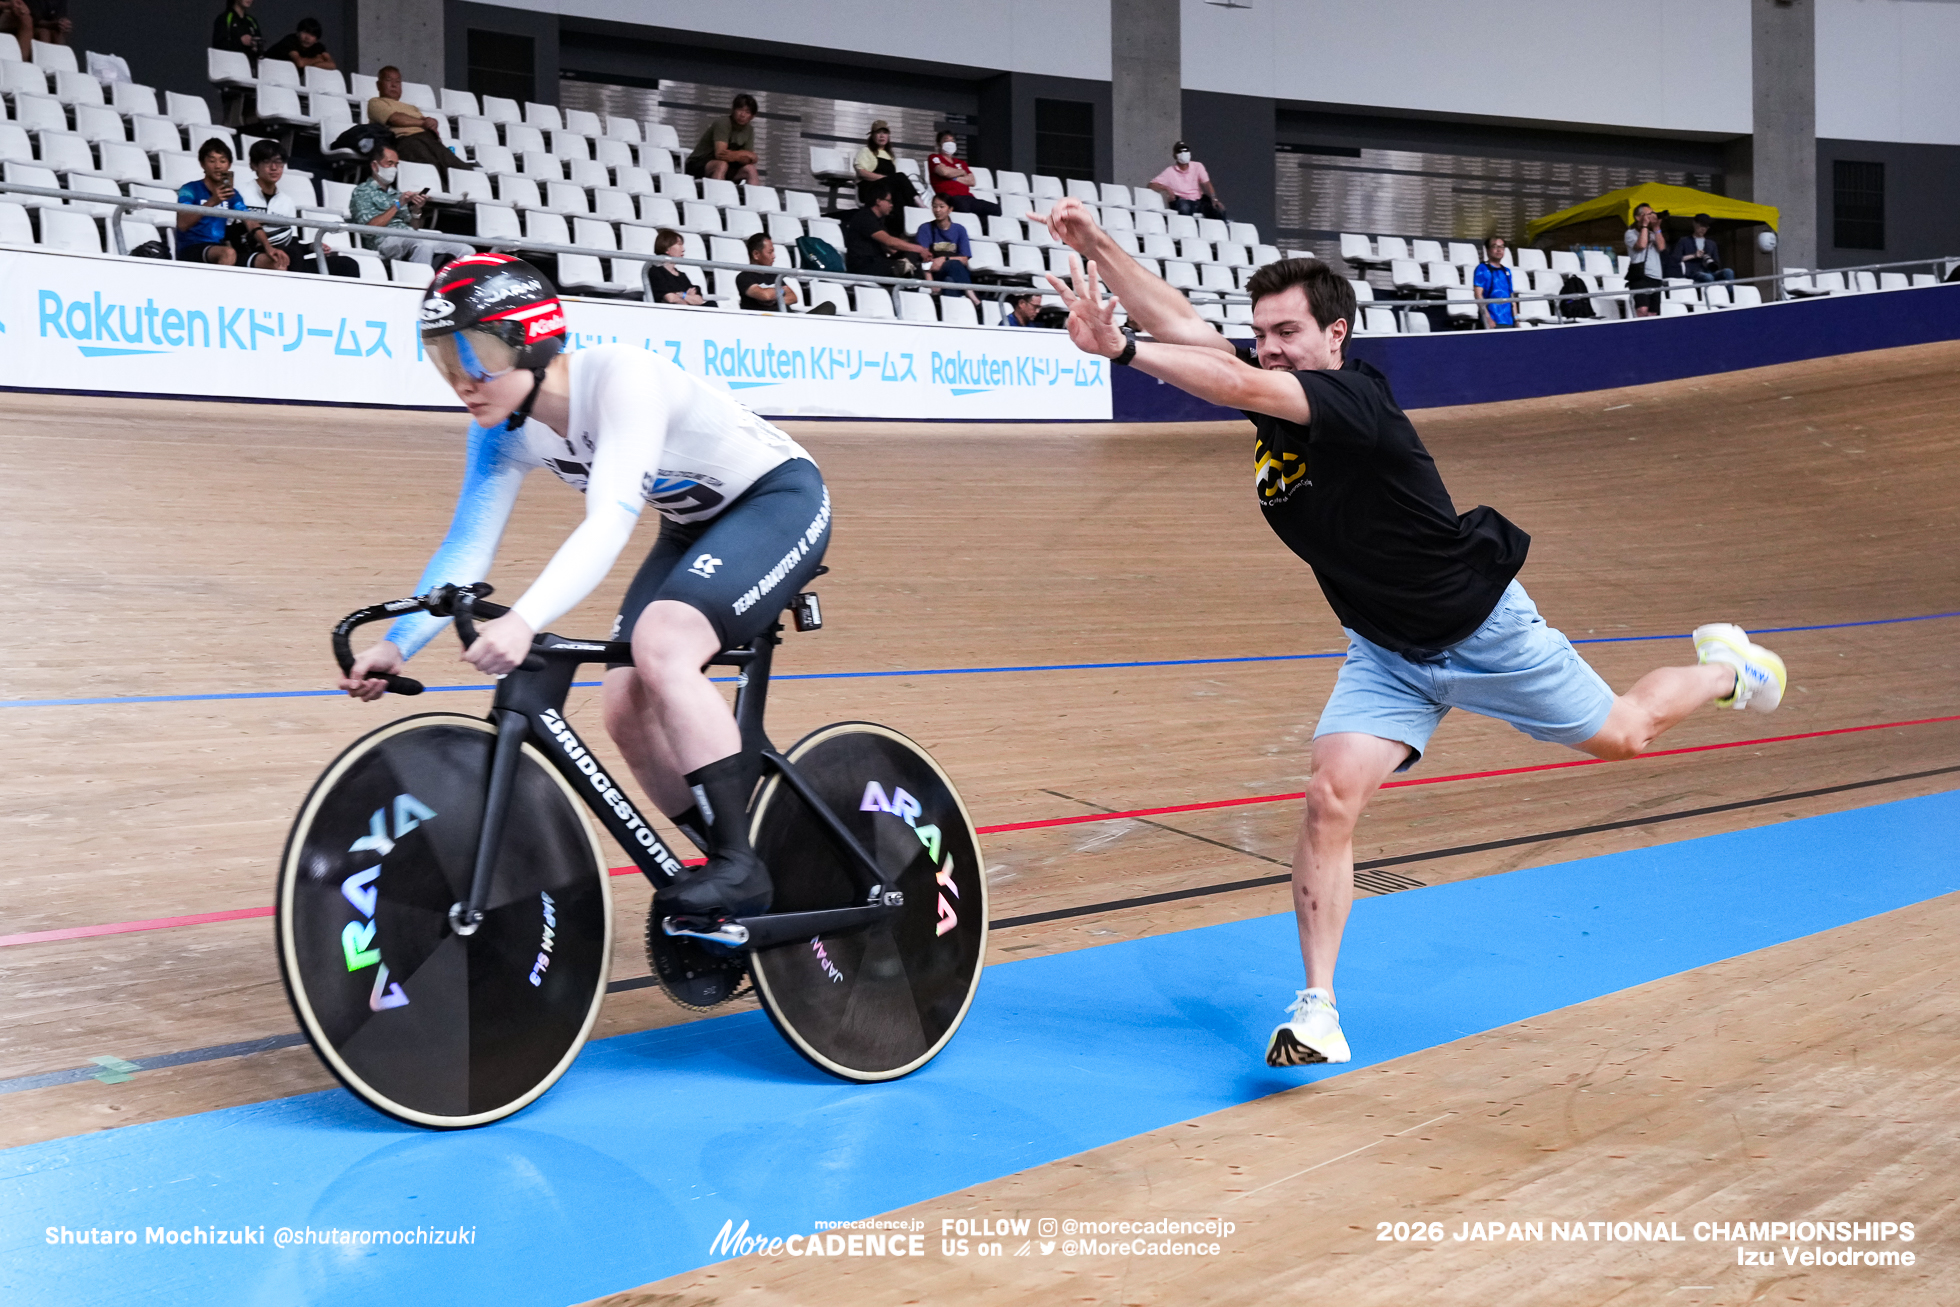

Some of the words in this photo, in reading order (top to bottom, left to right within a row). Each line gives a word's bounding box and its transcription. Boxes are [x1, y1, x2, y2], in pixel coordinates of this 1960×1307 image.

[38, 289, 211, 349] Rakuten
[218, 305, 393, 359] Kドリームス
[703, 338, 806, 380] Rakuten
[810, 346, 918, 383] Kドリームス
[931, 350, 1013, 386] Rakuten
[1016, 356, 1104, 387] Kドリームス
[539, 708, 682, 877] BRIDGESTONE
[858, 780, 961, 938] ARAYA
[340, 792, 438, 1013] ARAYA
[810, 934, 844, 984] JAPAN
